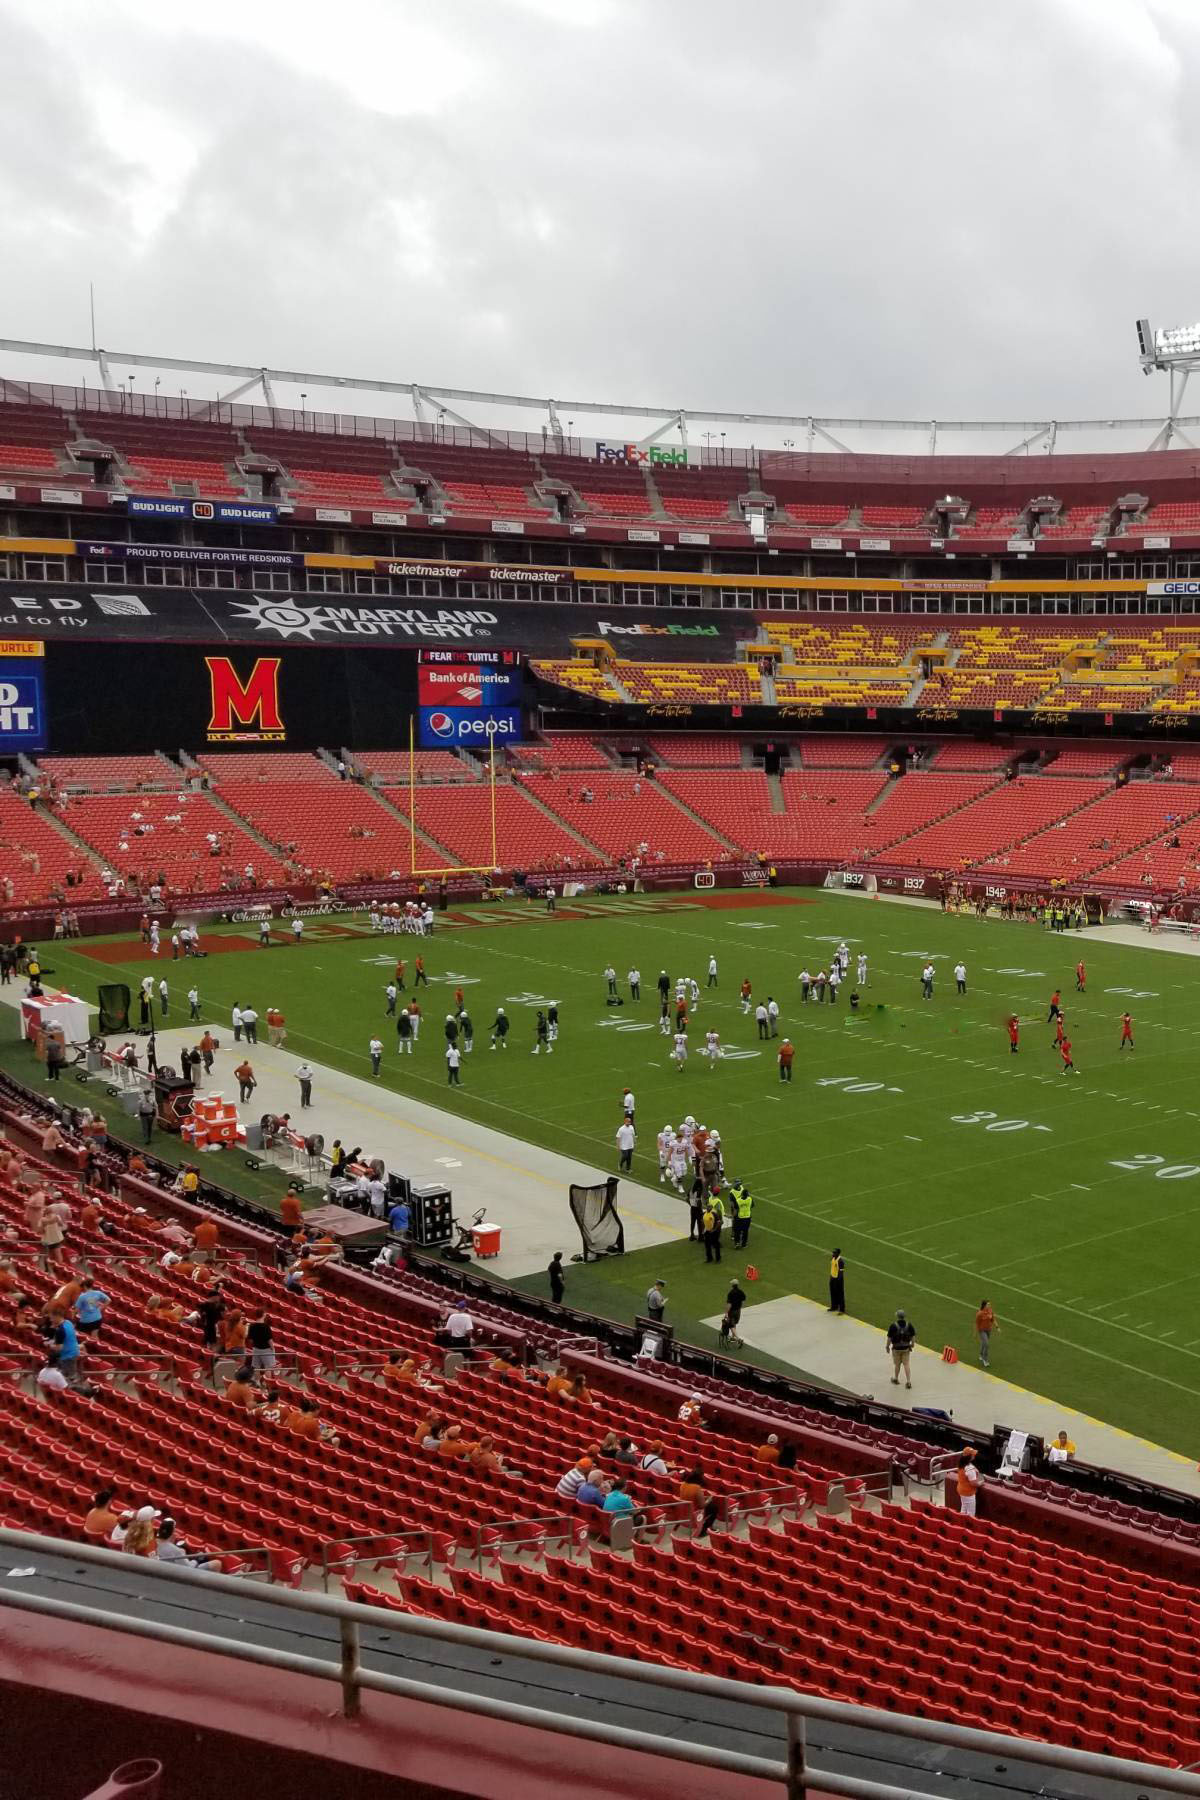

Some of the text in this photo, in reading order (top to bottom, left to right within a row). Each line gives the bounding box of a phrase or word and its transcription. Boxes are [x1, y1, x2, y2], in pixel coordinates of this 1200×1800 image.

[595, 442, 688, 464] FedExField
[133, 502, 185, 513] BUD LIGHT
[195, 505, 211, 516] 40
[221, 508, 272, 519] BUD LIGHT
[90, 546, 293, 564] FedEx PROUD TO DELIVER FOR THE REDSKINS.
[388, 563, 462, 577] ticketmaster
[489, 568, 560, 582] ticketmaster
[26, 616, 51, 625] to
[59, 616, 88, 627] fly
[322, 607, 497, 625] MARYLAND
[333, 620, 474, 638] LOTTERY
[597, 621, 720, 637] FedExField
[430, 672, 510, 683] Bank of America
[205, 656, 286, 731] M
[459, 716, 513, 737] pepsi
[698, 874, 713, 886] 40
[843, 872, 864, 884] 1937
[904, 876, 925, 889] 1937
[815, 1075, 885, 1093] 40
[950, 1110, 1030, 1132] 30
[221, 1128, 230, 1136] G
[944, 1347, 953, 1362] 10
